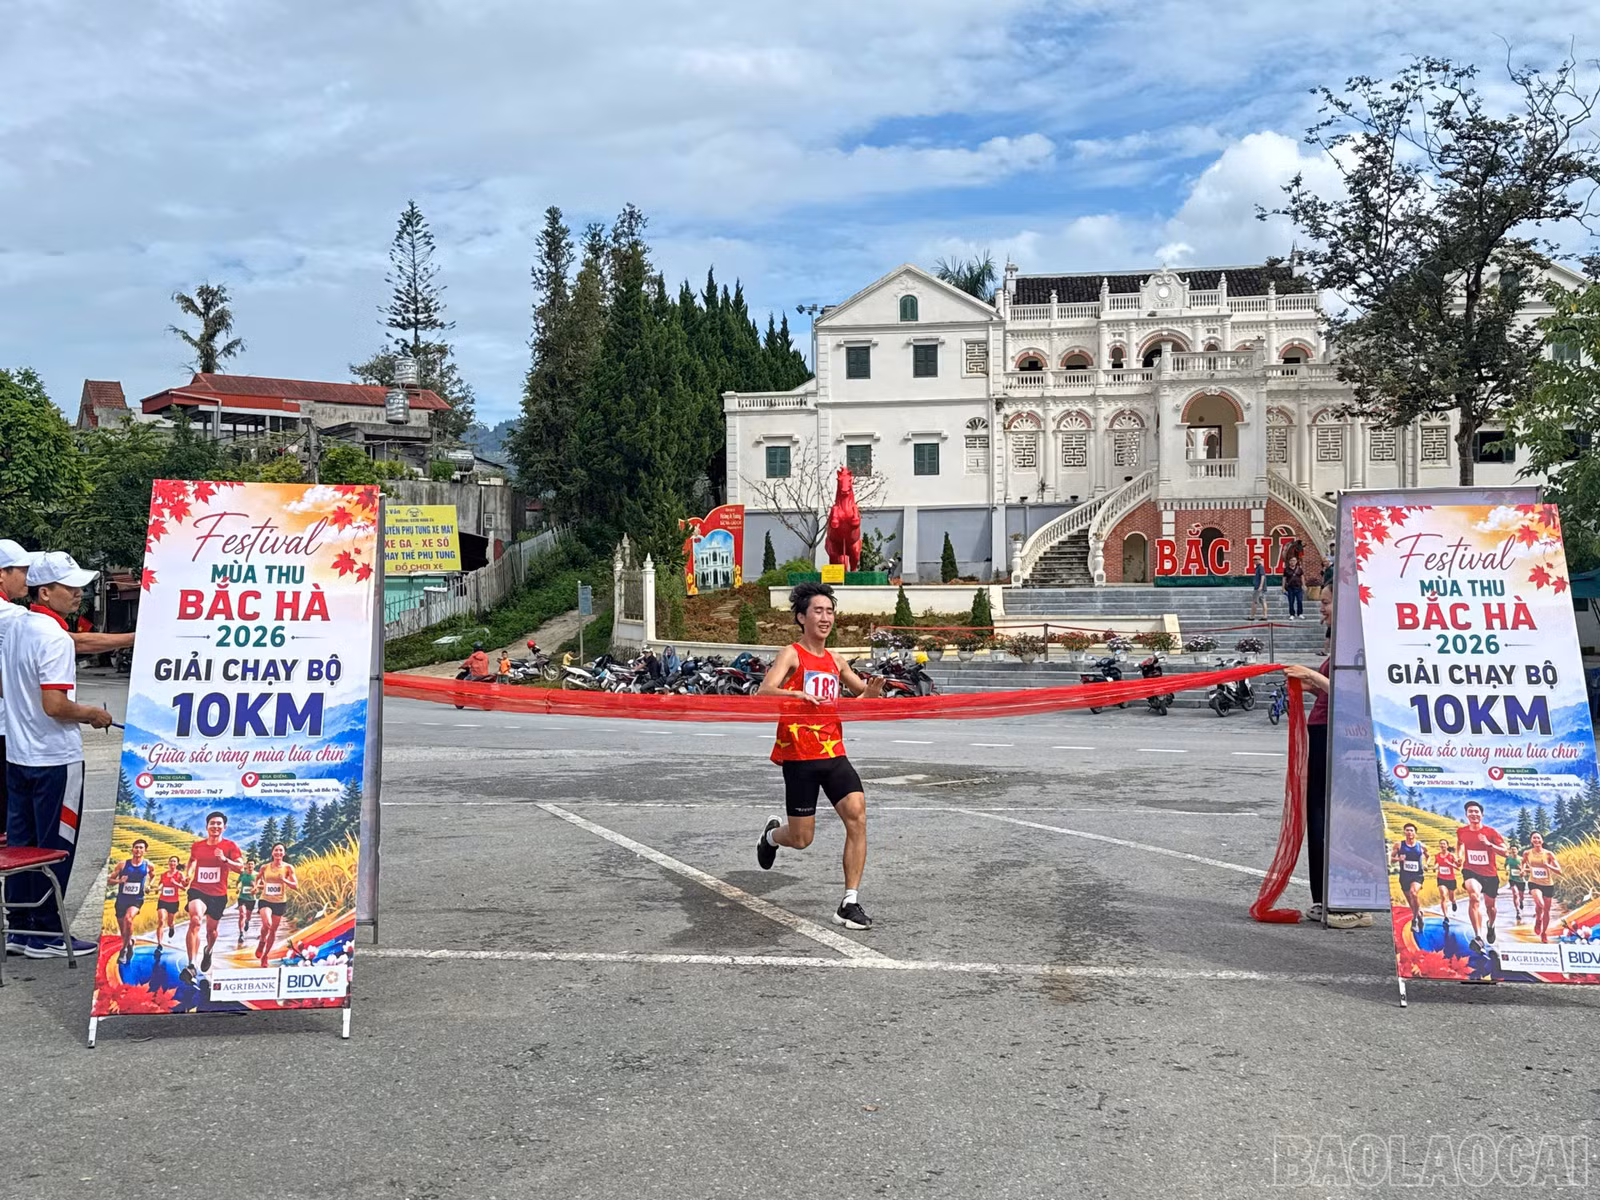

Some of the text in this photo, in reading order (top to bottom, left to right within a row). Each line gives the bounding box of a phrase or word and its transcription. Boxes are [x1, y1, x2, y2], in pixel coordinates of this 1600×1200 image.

[192, 511, 329, 562] Festival
[384, 525, 400, 535] UYÊN
[432, 525, 439, 534] XE
[384, 540, 396, 549] XE
[399, 539, 412, 548] GA
[422, 539, 433, 548] XE
[437, 536, 449, 548] SỐ
[1155, 523, 1232, 576] BẮC
[384, 552, 399, 560] HAY
[1394, 533, 1516, 578] Festival
[211, 560, 305, 584] MÙA THU
[1419, 575, 1505, 597] MÙA THU
[177, 577, 331, 621] BẮC HÀ
[1395, 592, 1538, 630] BẮC HÀ
[215, 625, 286, 648] 2026
[1436, 634, 1500, 654] 2026
[154, 651, 342, 687] GIẢI CHẠY BỘ
[1387, 658, 1440, 684] GIẢI
[1449, 664, 1516, 689] CHẠY
[1526, 660, 1558, 689] BỘ
[813, 677, 837, 701] 183
[172, 692, 324, 737] 10KM
[1410, 694, 1553, 735] 10KM
[189, 743, 213, 763] sắc
[215, 746, 250, 770] vàng
[252, 746, 286, 762] mùa
[288, 744, 313, 762] lúa
[1437, 740, 1458, 757] sắc
[1460, 743, 1490, 764] vàng
[1494, 743, 1524, 758] mùa
[1526, 742, 1549, 758] lúa
[1470, 854, 1487, 862] 1001
[200, 872, 218, 880] 1001
[1511, 955, 1559, 963] AGRIBANK
[1568, 951, 1600, 964] BIDV
[223, 982, 275, 991] AGRIBANK
[287, 974, 325, 988] BIDV
